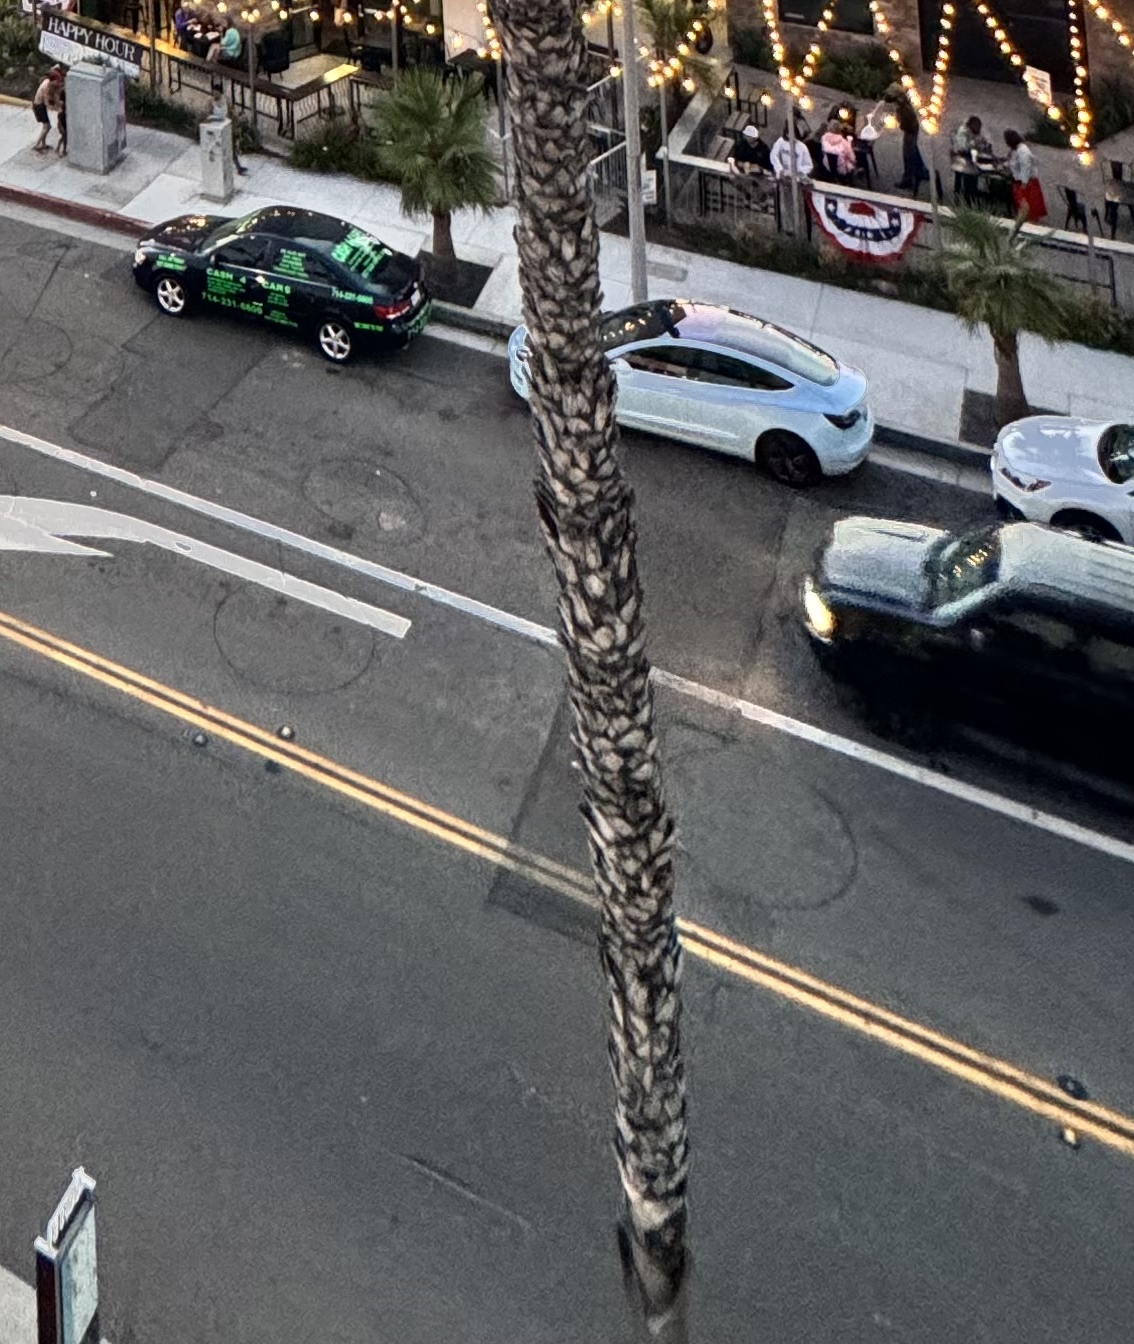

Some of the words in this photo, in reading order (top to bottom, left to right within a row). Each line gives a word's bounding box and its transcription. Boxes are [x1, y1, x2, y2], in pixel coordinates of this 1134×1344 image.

[48, 16, 93, 46] HAPPY
[95, 32, 135, 61] HOUR
[206, 267, 234, 281] CASH
[239, 276, 246, 285] 4
[262, 281, 291, 295] CARS
